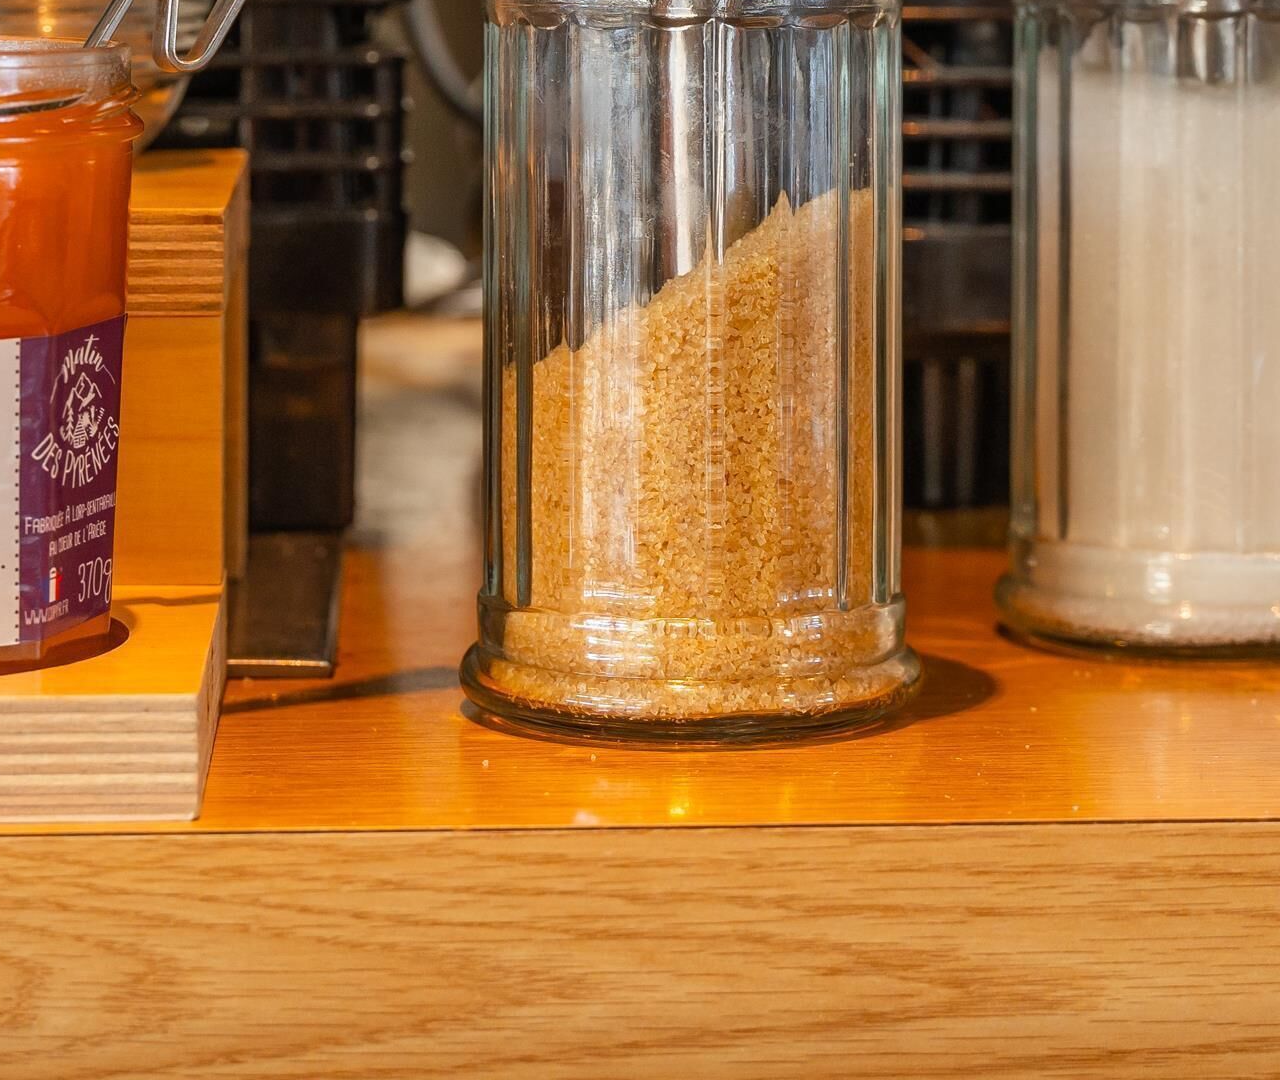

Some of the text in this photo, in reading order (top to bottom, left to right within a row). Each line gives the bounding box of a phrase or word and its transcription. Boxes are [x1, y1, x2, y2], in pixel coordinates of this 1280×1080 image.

[62, 334, 105, 383] Matin
[31, 416, 119, 488] DES PYRÉNÉES
[78, 557, 112, 604] 370g
